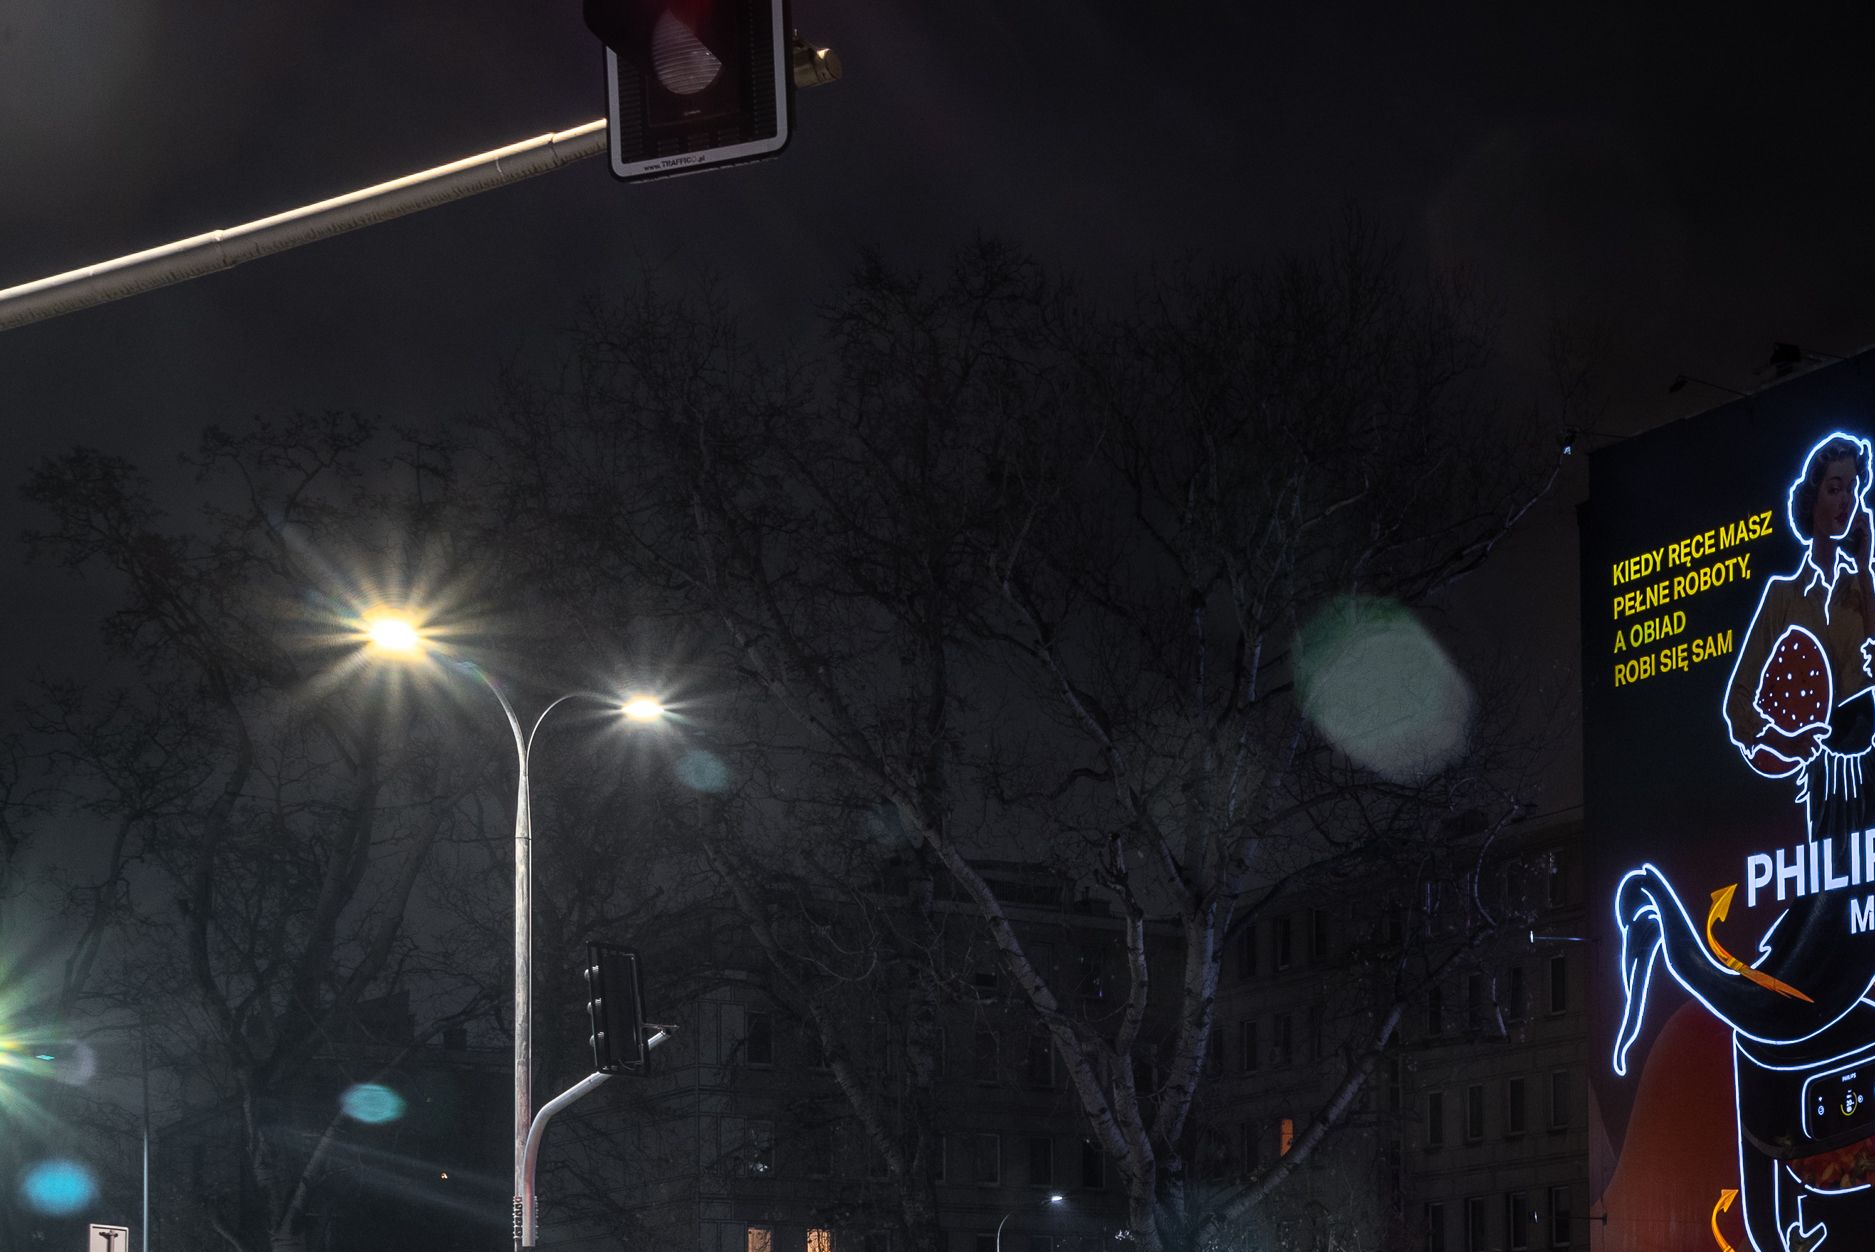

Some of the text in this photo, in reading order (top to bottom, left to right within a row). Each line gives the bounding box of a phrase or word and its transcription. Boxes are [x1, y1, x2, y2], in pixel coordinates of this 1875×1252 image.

[1614, 511, 1772, 585] KIEDY RĘCE MASZ
[1614, 554, 1750, 619] PEŁNE ROBOTY,
[1614, 611, 1685, 654] A OBIAD
[1615, 630, 1732, 686] ROBI SIĘ SAM
